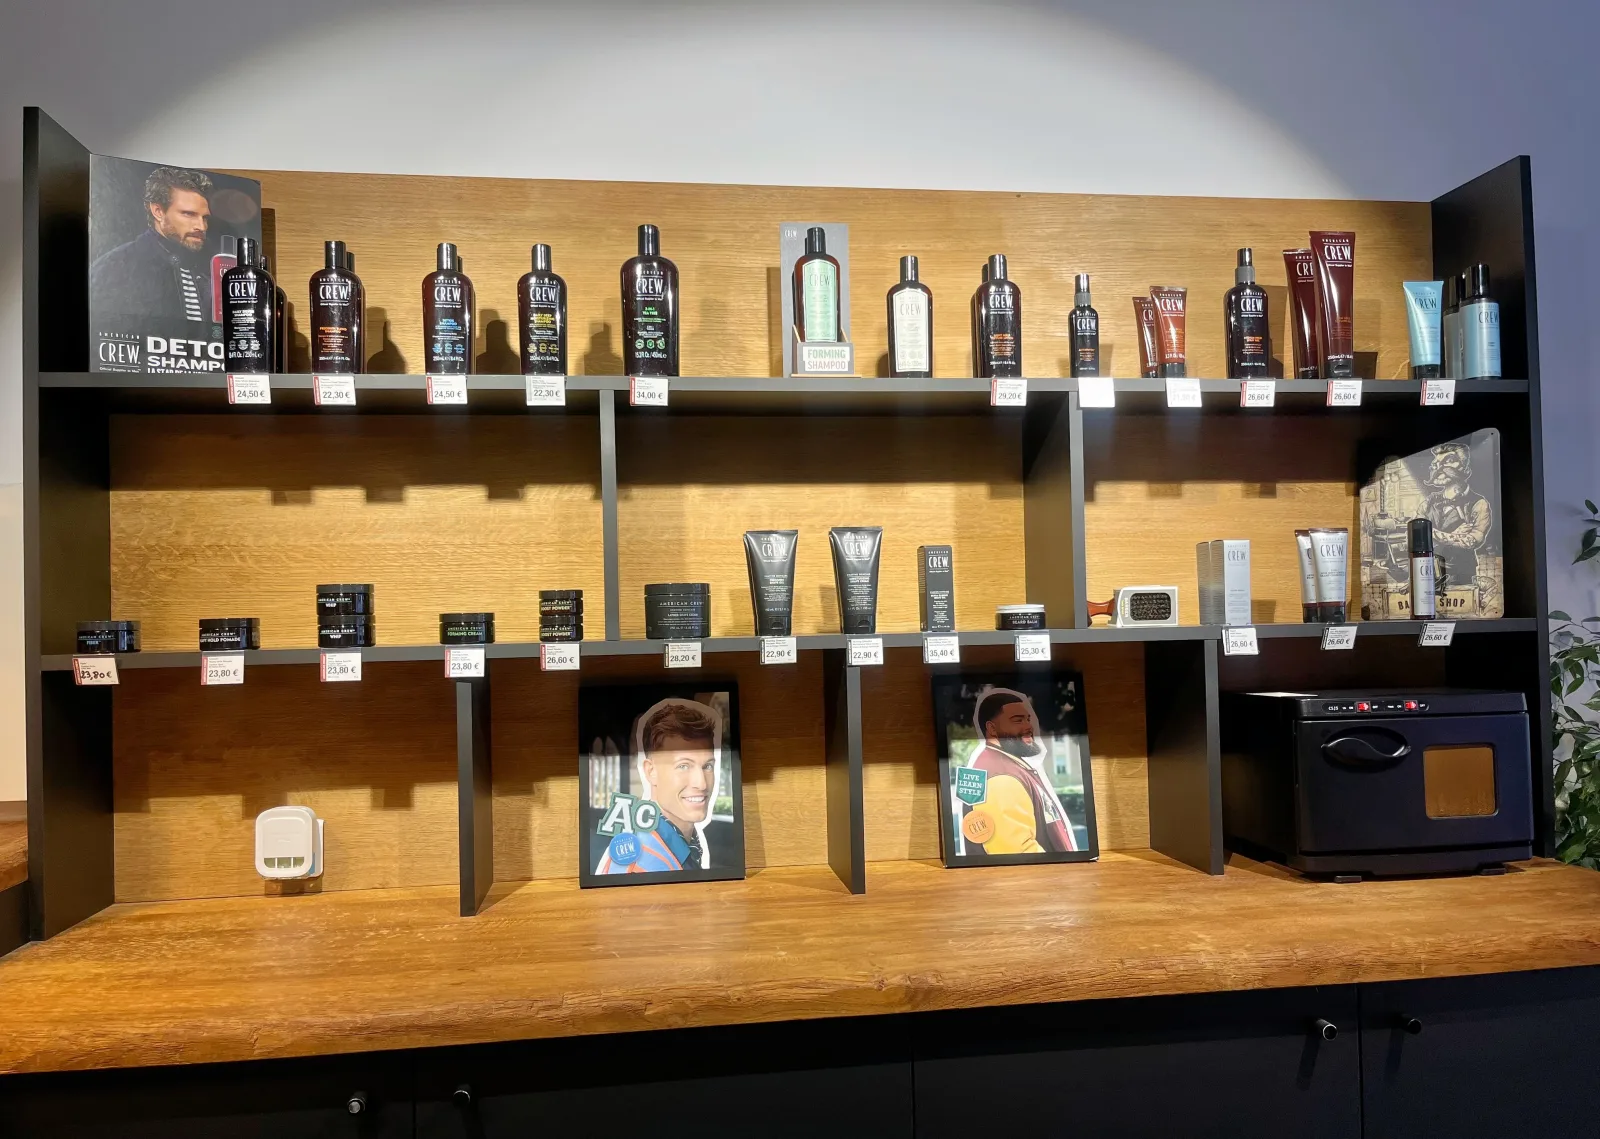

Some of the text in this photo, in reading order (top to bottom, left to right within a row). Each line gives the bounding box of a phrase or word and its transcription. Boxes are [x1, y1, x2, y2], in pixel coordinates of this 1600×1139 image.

[1297, 262, 1314, 276] CRE
[1143, 309, 1153, 321] CR
[99, 332, 140, 340] AMERICAN
[147, 336, 225, 360] DETO
[808, 349, 846, 358] FORMING
[147, 356, 225, 373] SHAMP
[808, 360, 846, 370] SHAMPOO
[237, 390, 265, 399] 24,50 €
[322, 391, 350, 400] 22,30 €
[434, 391, 455, 401] 24,50
[534, 390, 554, 400] 22,30
[636, 391, 656, 399] 34,00
[998, 392, 1015, 401] 29,20
[1247, 393, 1270, 401] 26,60 €
[1334, 393, 1351, 401] 26,60
[1228, 550, 1247, 561] CREW
[1320, 545, 1344, 557] CREW
[1439, 599, 1465, 608] SHOP
[1231, 640, 1247, 648] 26,60
[1327, 638, 1344, 646] 26,60
[766, 650, 785, 659] 22,90
[853, 651, 872, 660] 22,90
[929, 650, 948, 658] 35,40
[1021, 648, 1039, 656] 25,30
[327, 666, 349, 675] 23,80
[451, 662, 472, 671] 23,80
[80, 671, 105, 681] 23,80
[209, 669, 238, 678] 23,80 €
[963, 773, 980, 781] LIVE
[958, 780, 983, 789] LEARN
[958, 788, 982, 797] STYLE
[968, 820, 987, 834] CREW
[615, 842, 635, 855] CREW
